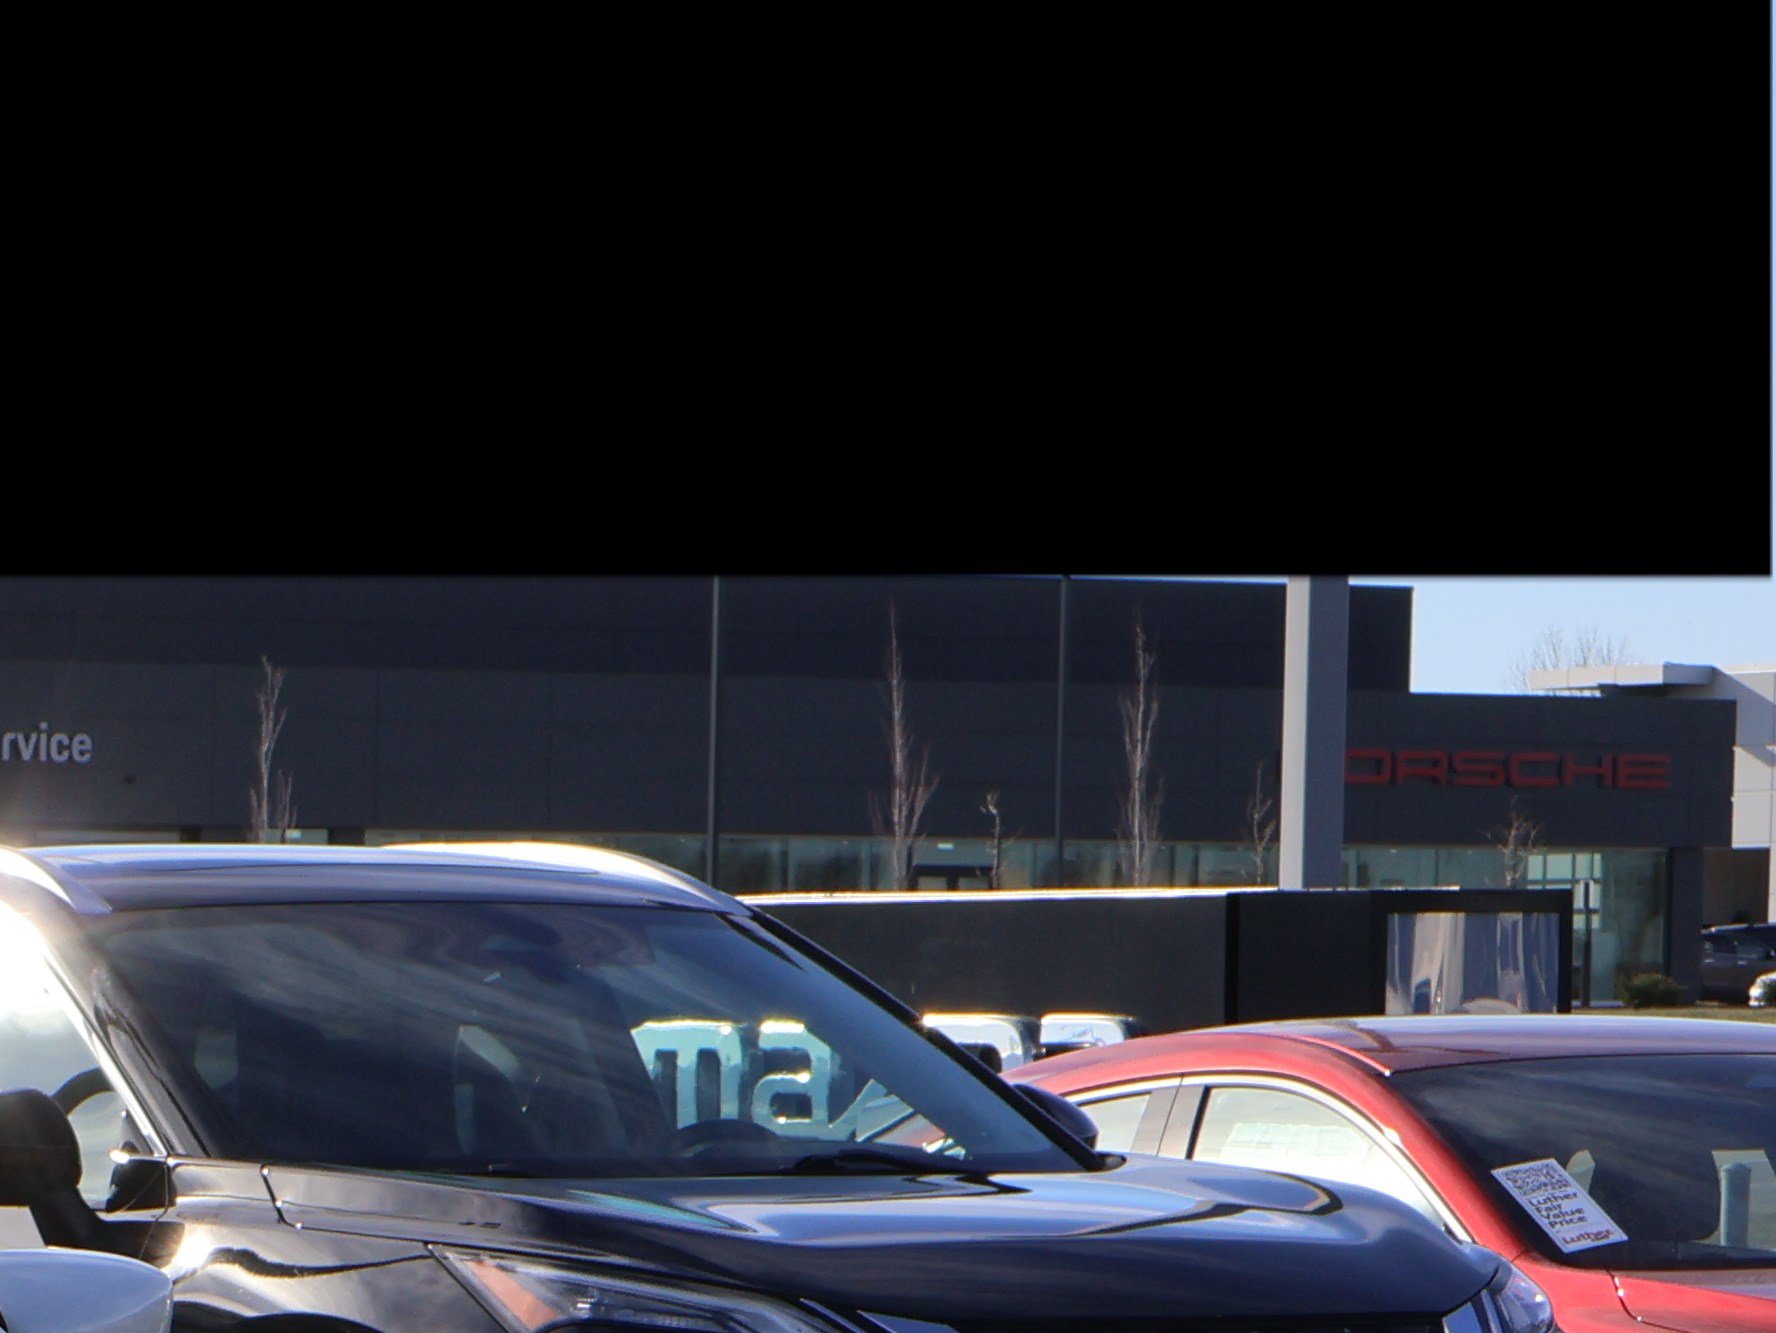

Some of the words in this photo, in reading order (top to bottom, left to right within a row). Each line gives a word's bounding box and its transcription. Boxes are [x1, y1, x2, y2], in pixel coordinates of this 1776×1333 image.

[1344, 748, 1671, 789] ORSCHE
[1528, 1191, 1579, 1207] Luther
[1536, 1203, 1563, 1214] Fair
[1541, 1207, 1585, 1220] Value
[1548, 1216, 1588, 1229] Price
[1561, 1228, 1615, 1245] Luther
